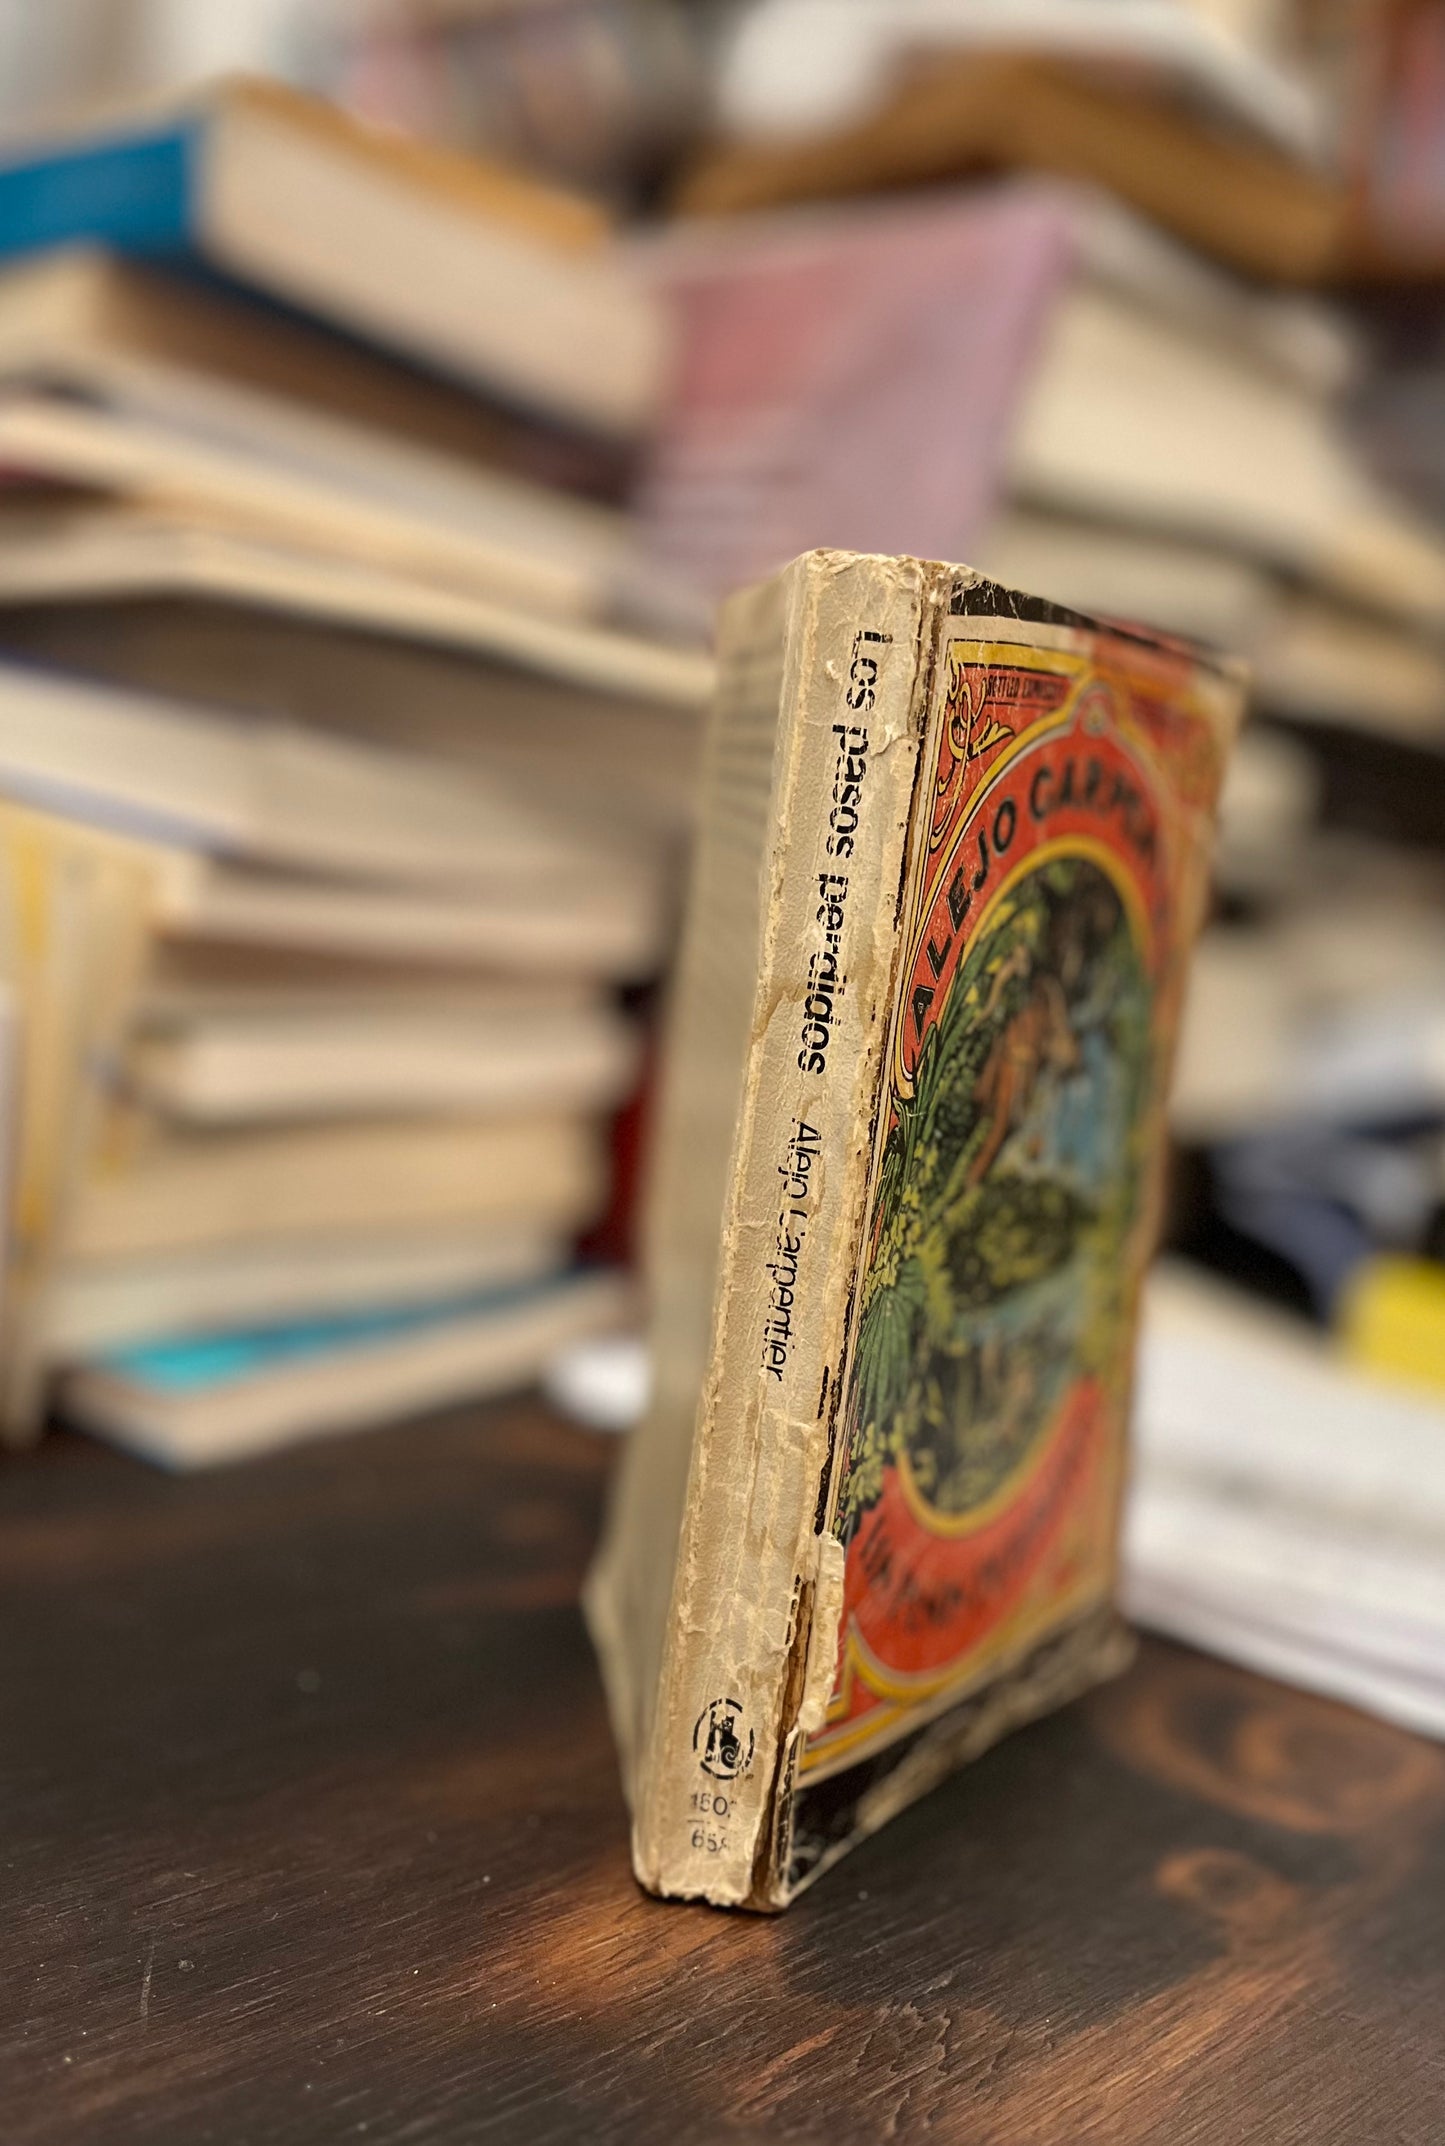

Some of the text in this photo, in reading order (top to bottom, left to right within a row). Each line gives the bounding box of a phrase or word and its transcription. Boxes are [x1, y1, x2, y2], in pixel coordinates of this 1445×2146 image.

[845, 630, 893, 712] Los
[826, 722, 869, 860] pasos
[911, 796, 1017, 1045] ALEJO
[760, 1117, 822, 1382] Alejo Carpentier
